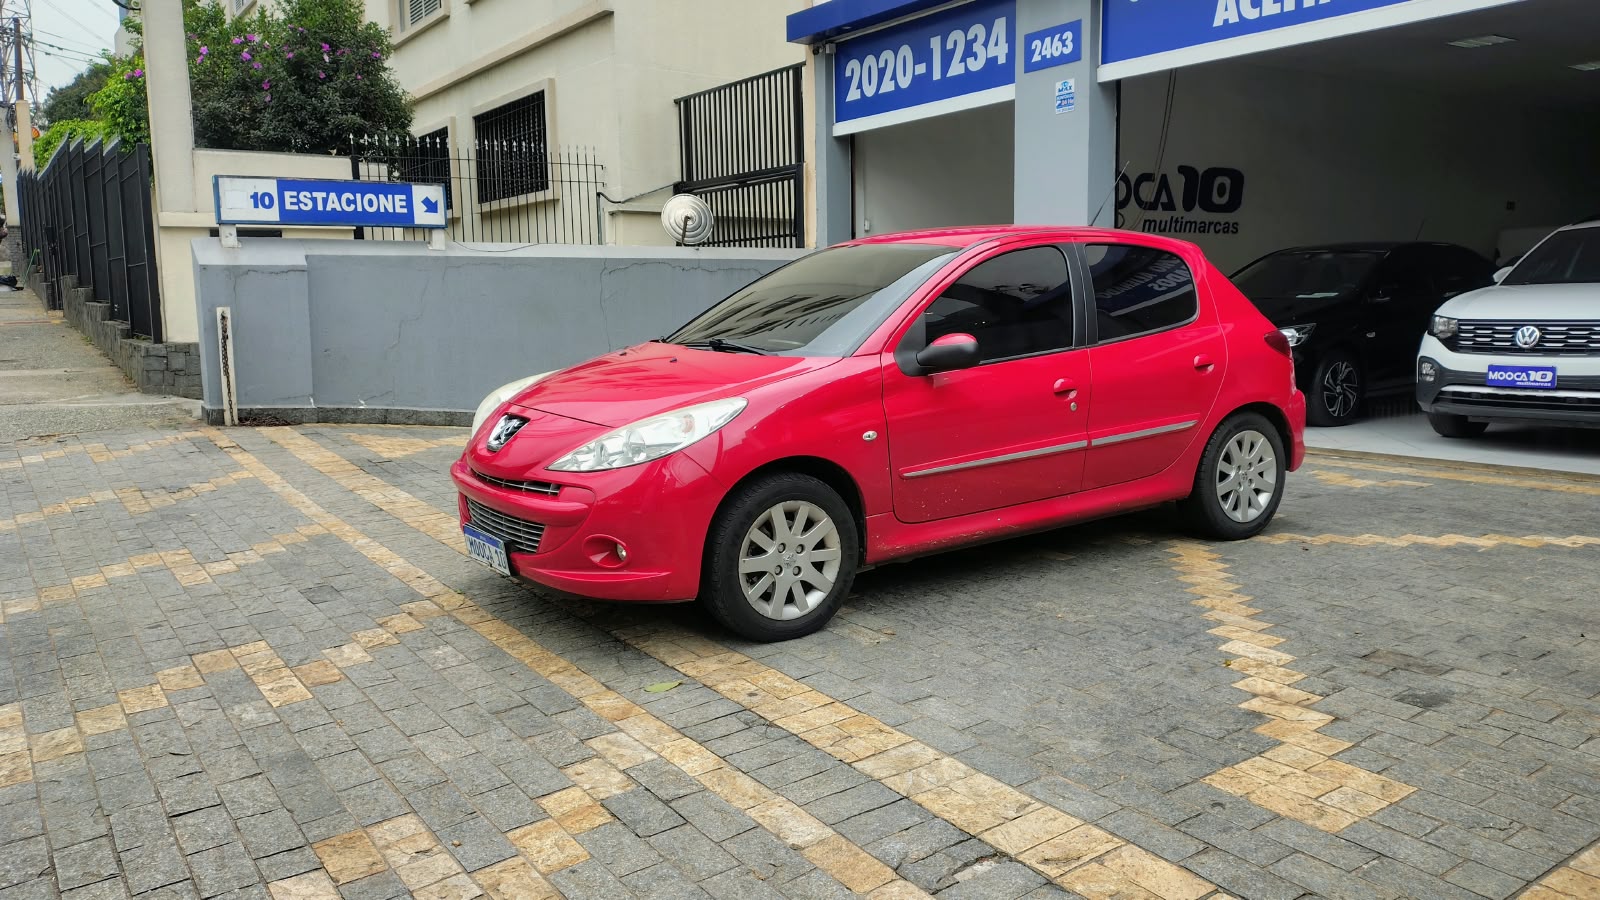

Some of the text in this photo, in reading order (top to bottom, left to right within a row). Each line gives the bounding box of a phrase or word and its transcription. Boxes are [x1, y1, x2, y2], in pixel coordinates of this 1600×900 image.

[845, 16, 1009, 103] 2020-1234
[1030, 31, 1074, 63] 2463
[250, 190, 408, 213] 10 ESTACIONE
[1141, 216, 1240, 234] multimarcas
[468, 536, 495, 564] MOOCA
